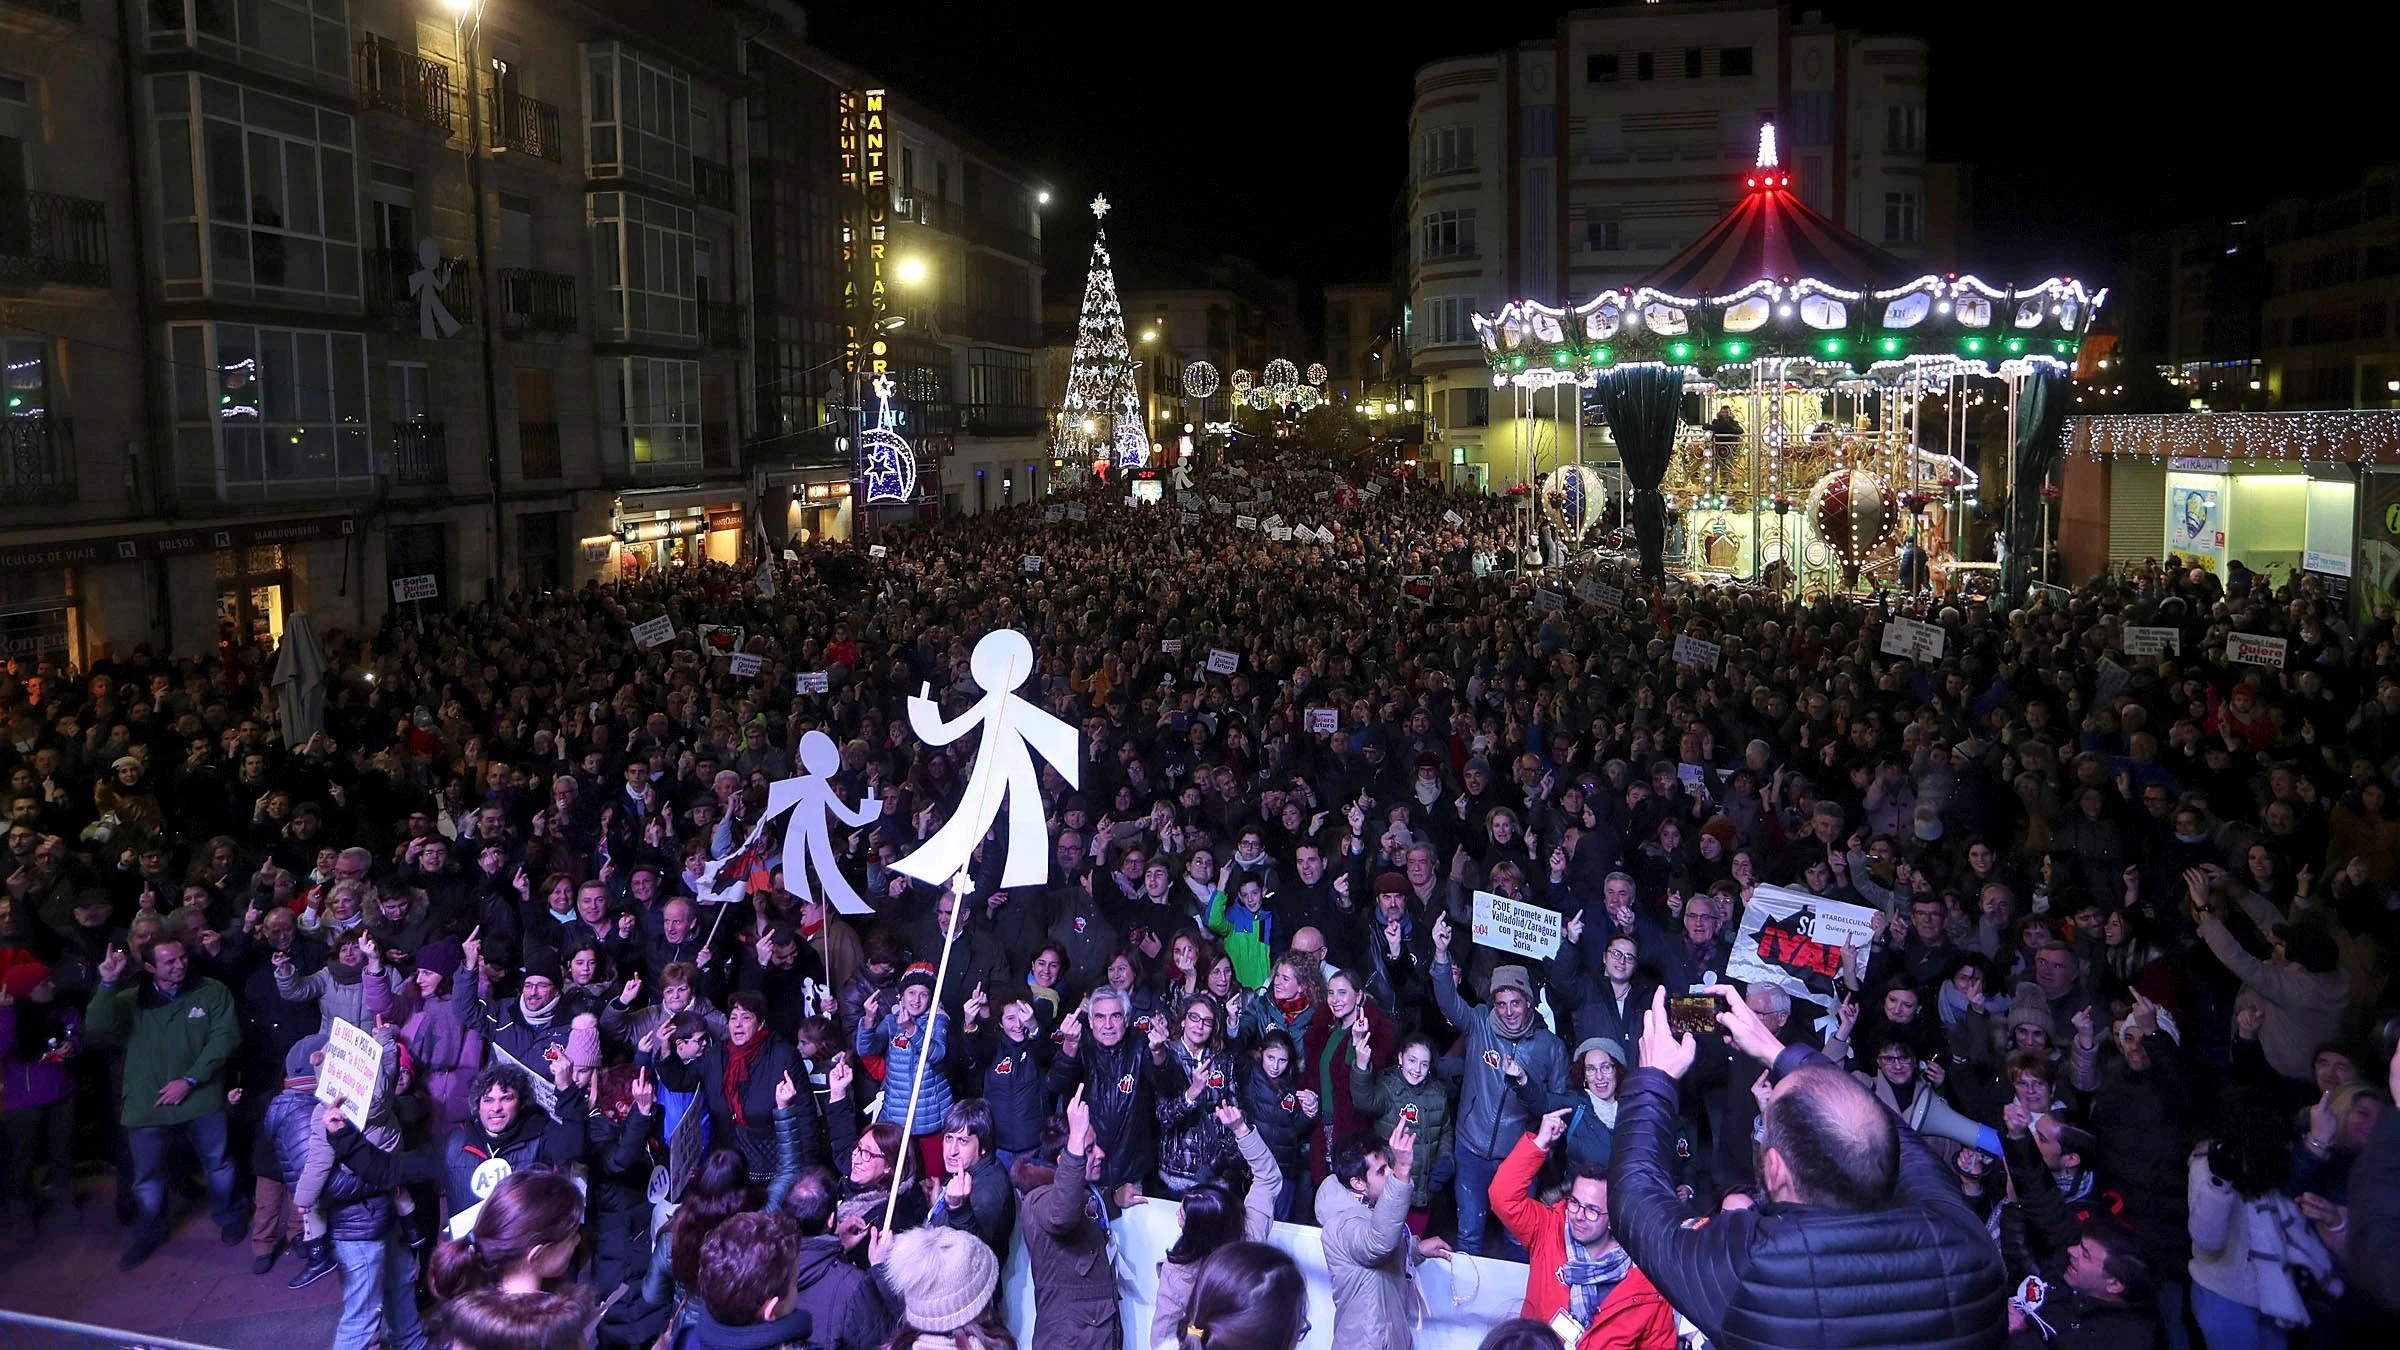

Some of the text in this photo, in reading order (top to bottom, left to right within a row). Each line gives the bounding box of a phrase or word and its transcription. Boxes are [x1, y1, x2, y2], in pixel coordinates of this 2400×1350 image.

[654, 520, 682, 536] YORK
[47, 550, 61, 563] DE
[65, 546, 97, 561] VIAJE
[403, 576, 429, 585] Soria
[405, 589, 436, 599] Futuro
[2239, 642, 2283, 657] Quiere
[1214, 662, 1234, 671] Futuro
[2238, 652, 2282, 666] Futuro
[1492, 899, 1558, 926] PSOE promete AVE
[1492, 910, 1557, 937] Valladolid/Zaragoza
[1821, 913, 1871, 928] #TARDELCUEND
[1473, 924, 1488, 936] 2004
[1499, 925, 1549, 946] con parada en
[1825, 924, 1867, 937] Quiere Futuro
[1513, 938, 1533, 952] Soria.
[1757, 924, 1842, 978] ¡YA!
[476, 1166, 507, 1190] A-11
[649, 1169, 667, 1198] A-11
